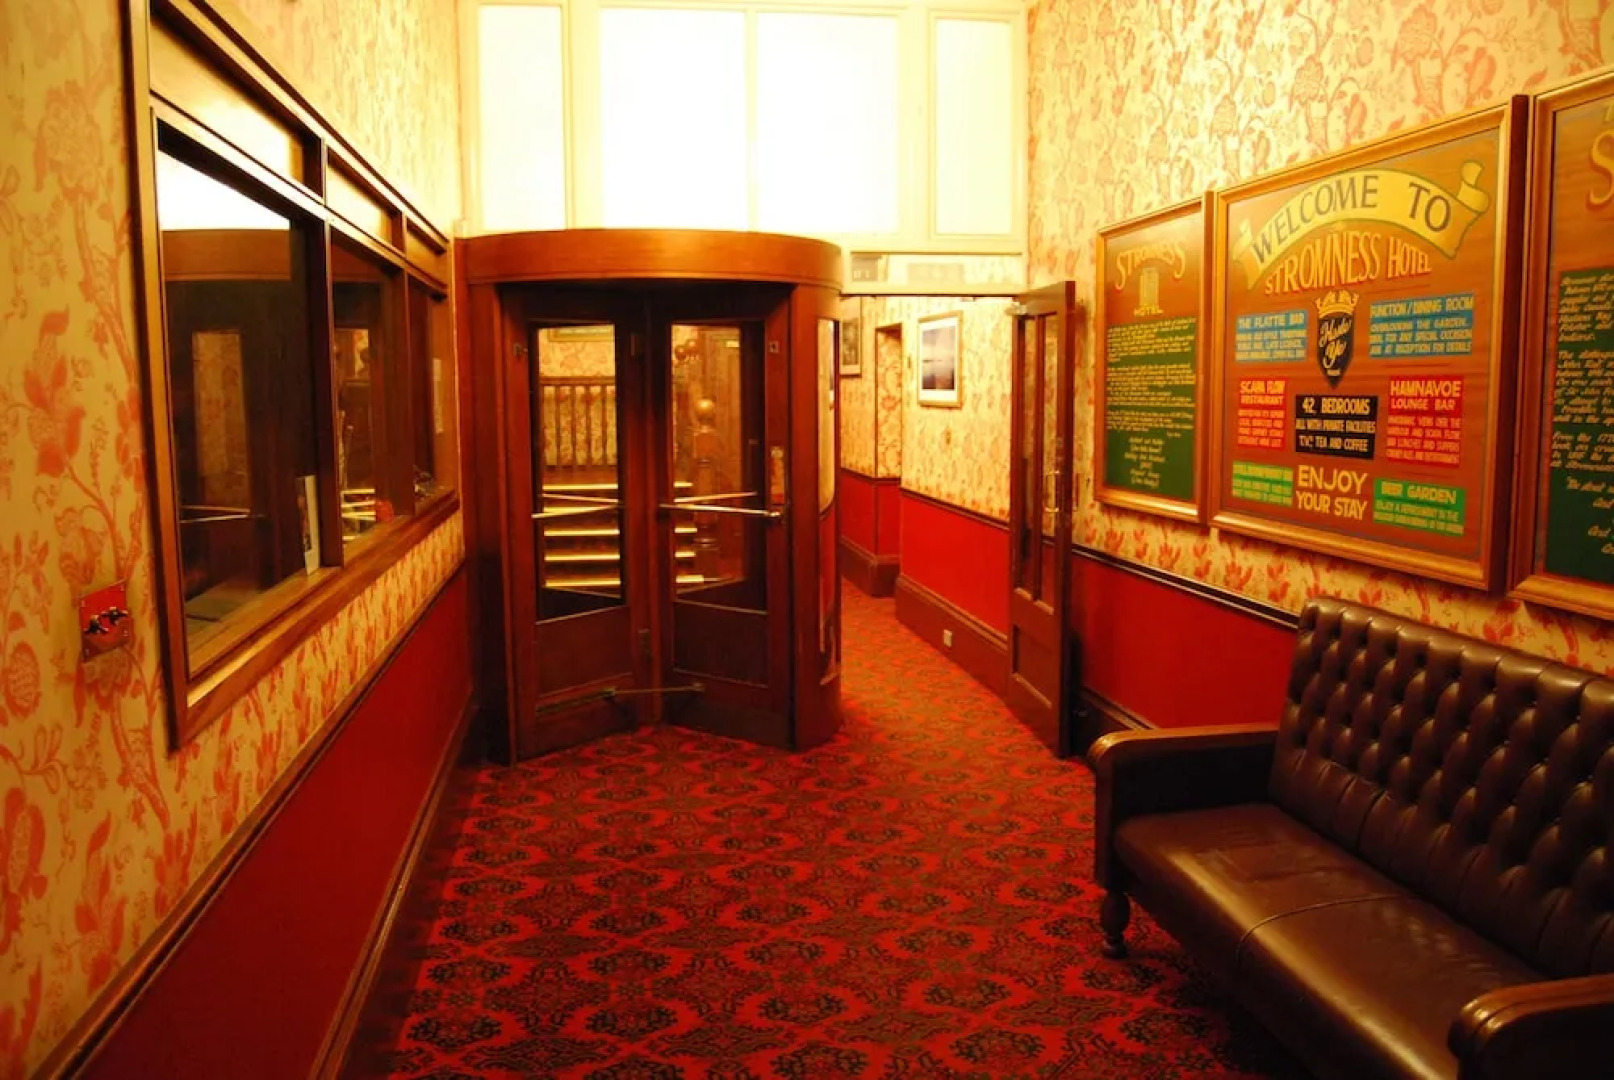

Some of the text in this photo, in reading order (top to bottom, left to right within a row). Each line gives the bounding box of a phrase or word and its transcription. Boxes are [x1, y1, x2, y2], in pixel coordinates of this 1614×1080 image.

[1250, 174, 1451, 264] WELCOME TO
[1264, 230, 1432, 295] STROMNESS HOTEL
[1446, 296, 1473, 312] ROOM
[1390, 380, 1462, 397] HAMNAVOE
[1322, 397, 1371, 415] BEDROOMS
[1390, 398, 1456, 411] LOUNGE BAR
[1344, 438, 1368, 452] COFFEE
[1297, 464, 1368, 495] ENJOY
[1407, 485, 1457, 505] GARDEN
[1295, 490, 1330, 514] YOUR
[1334, 499, 1368, 521] STAY
